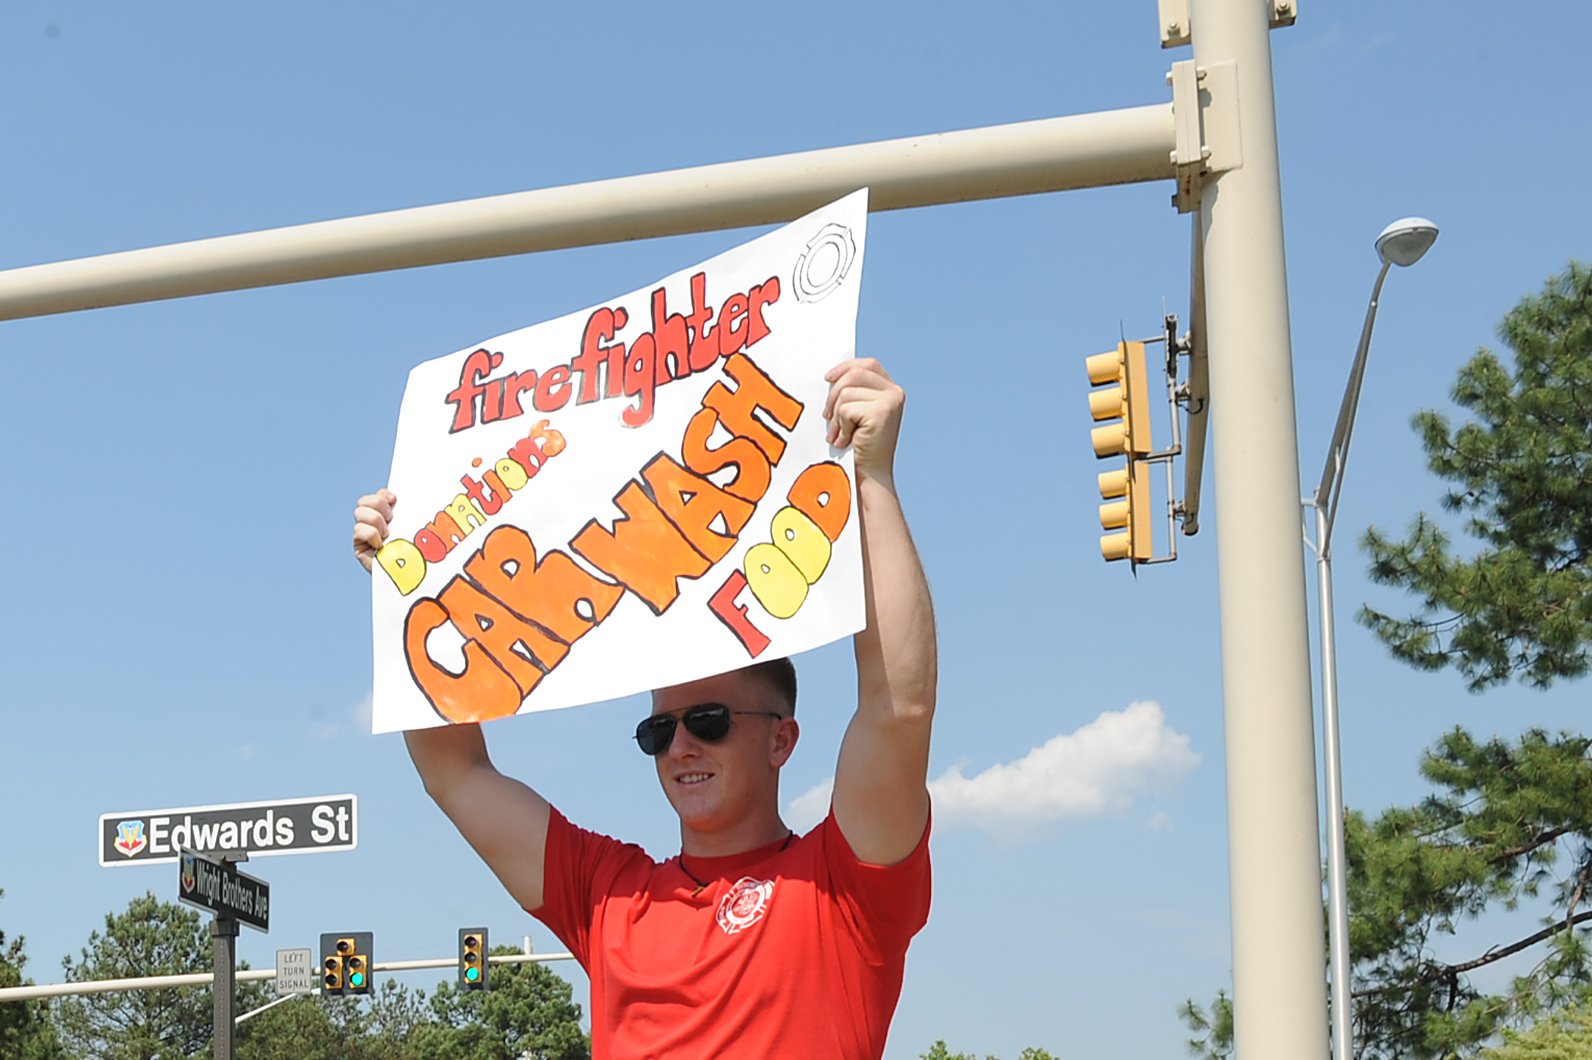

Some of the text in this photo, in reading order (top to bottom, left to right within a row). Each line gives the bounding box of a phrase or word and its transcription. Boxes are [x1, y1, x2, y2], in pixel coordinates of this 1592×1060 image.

[444, 272, 780, 434] firefighter
[403, 352, 804, 724] CAR WASH
[707, 461, 852, 659] FOOD
[149, 804, 350, 854] Edwards St
[196, 859, 268, 921] Wright Brothers Ave
[279, 979, 309, 989] SIGNAL
[283, 966, 305, 976] TURN
[284, 954, 303, 963] LEFT
